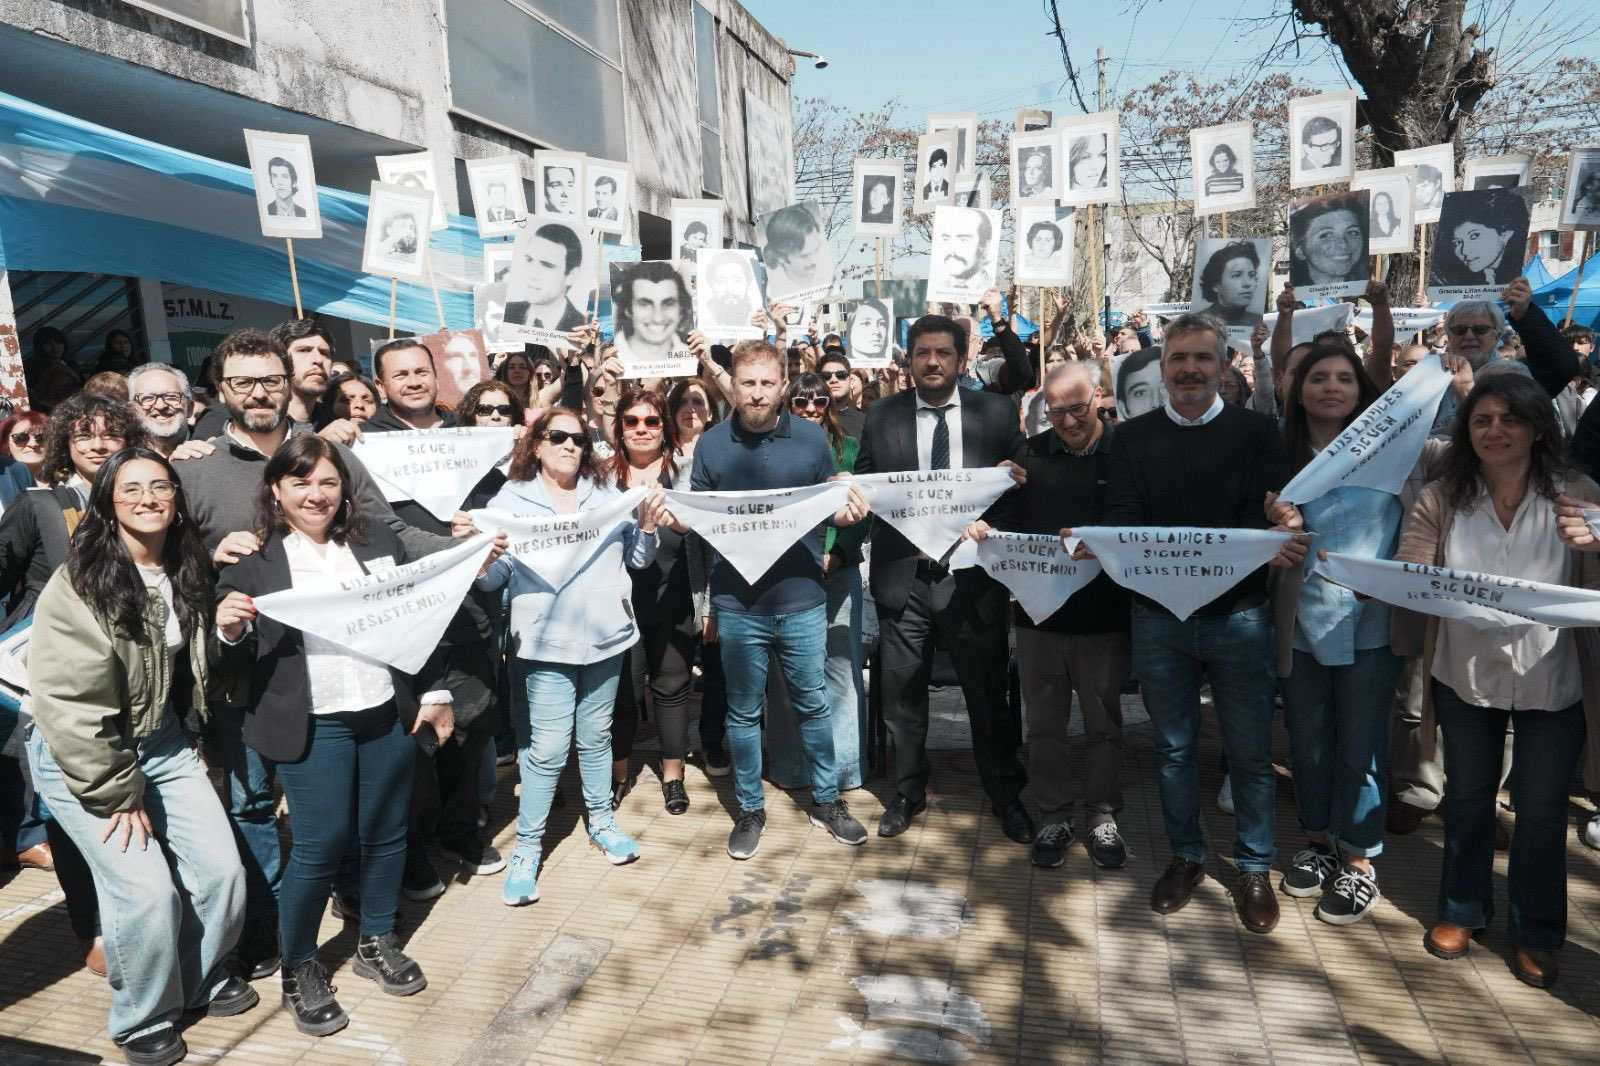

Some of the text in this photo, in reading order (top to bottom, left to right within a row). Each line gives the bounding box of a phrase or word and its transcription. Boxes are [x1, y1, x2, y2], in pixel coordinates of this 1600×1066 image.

[888, 474, 912, 484] LOS
[891, 504, 976, 519] RESISTIENDO
[514, 527, 600, 555] RESISTIENDO
[1118, 532, 1149, 544] LOS
[1144, 549, 1203, 558] SIGUEN
[991, 559, 1077, 576] RESISTIENDO
[1124, 564, 1235, 578] RESISTIENDO
